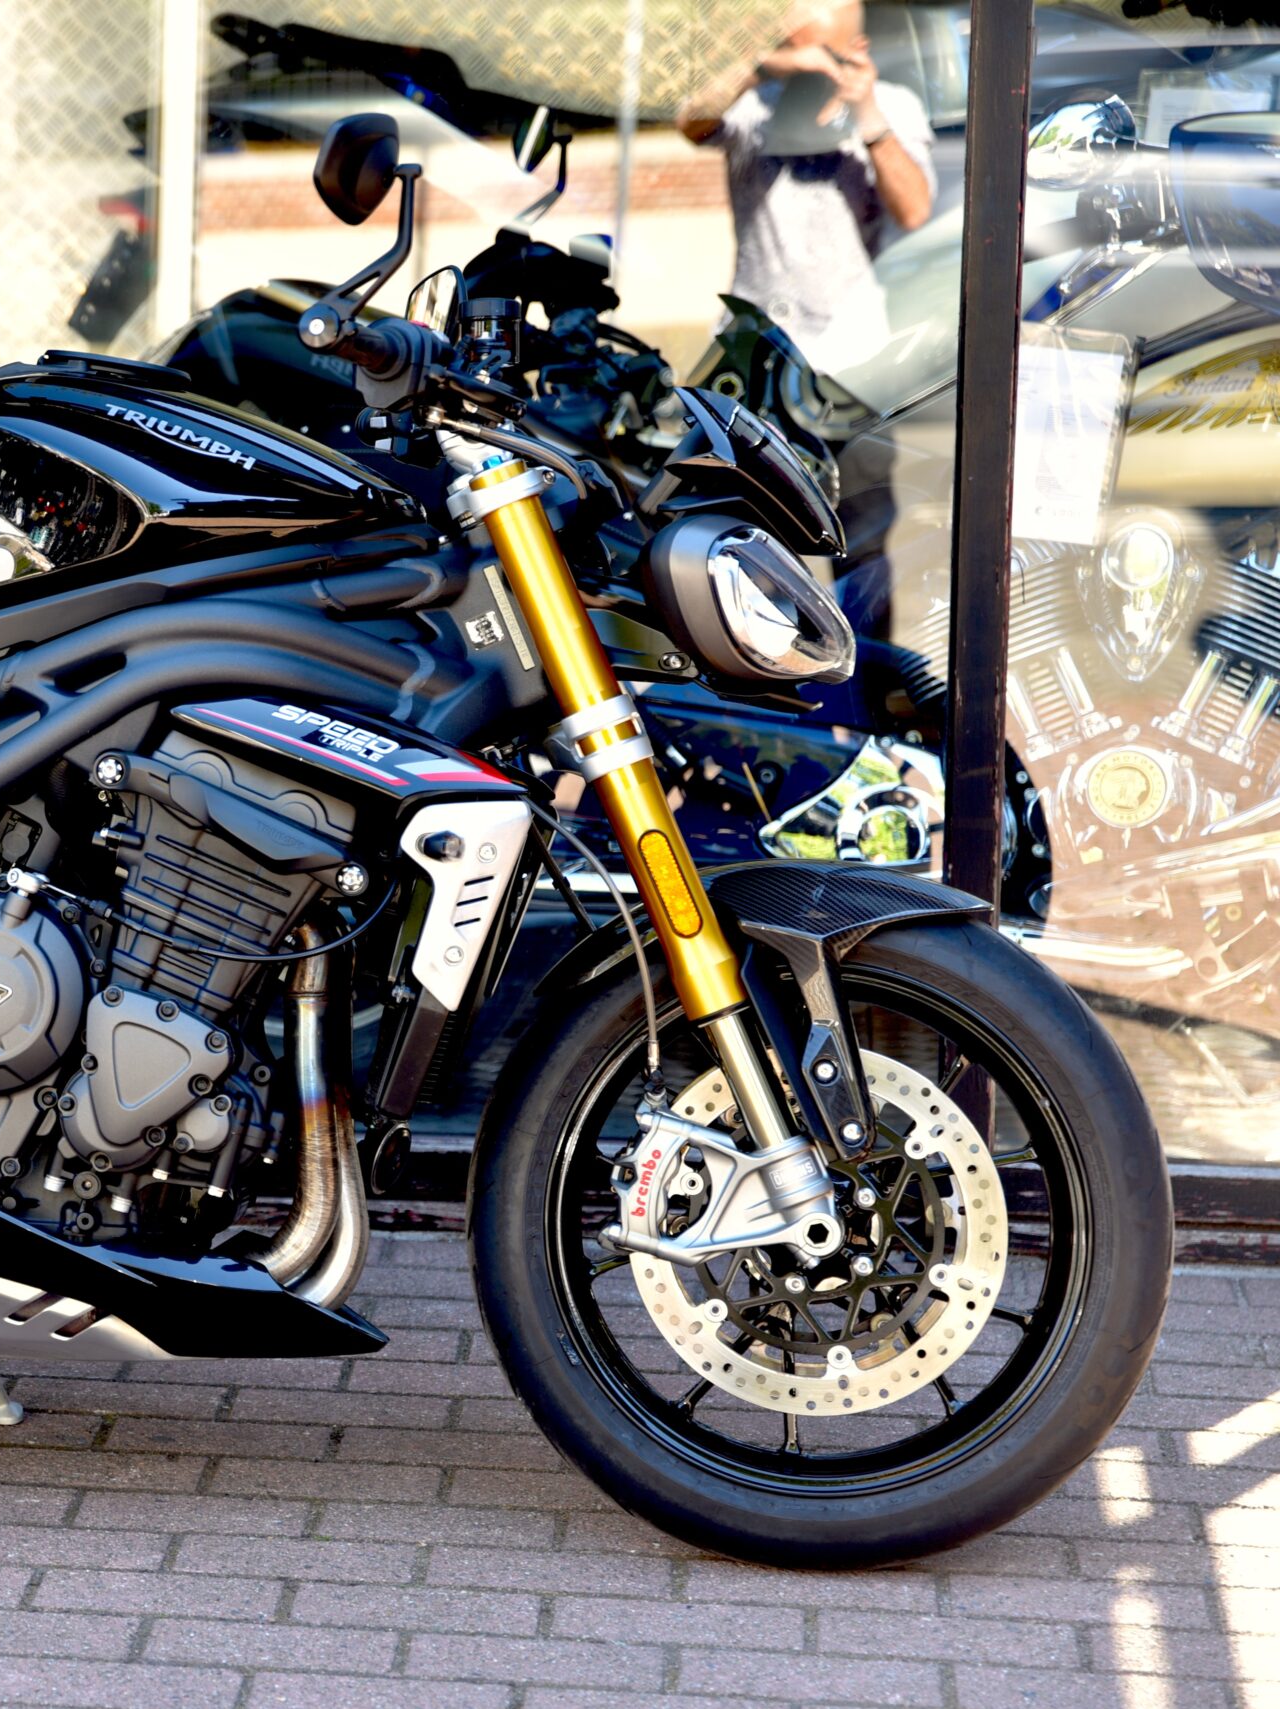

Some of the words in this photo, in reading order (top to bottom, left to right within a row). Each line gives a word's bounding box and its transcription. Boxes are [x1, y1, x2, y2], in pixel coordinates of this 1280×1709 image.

[105, 403, 257, 471] TRIUMPH
[271, 704, 401, 755] SPEED
[320, 735, 384, 762] TRIPLE
[631, 1149, 662, 1217] brembo
